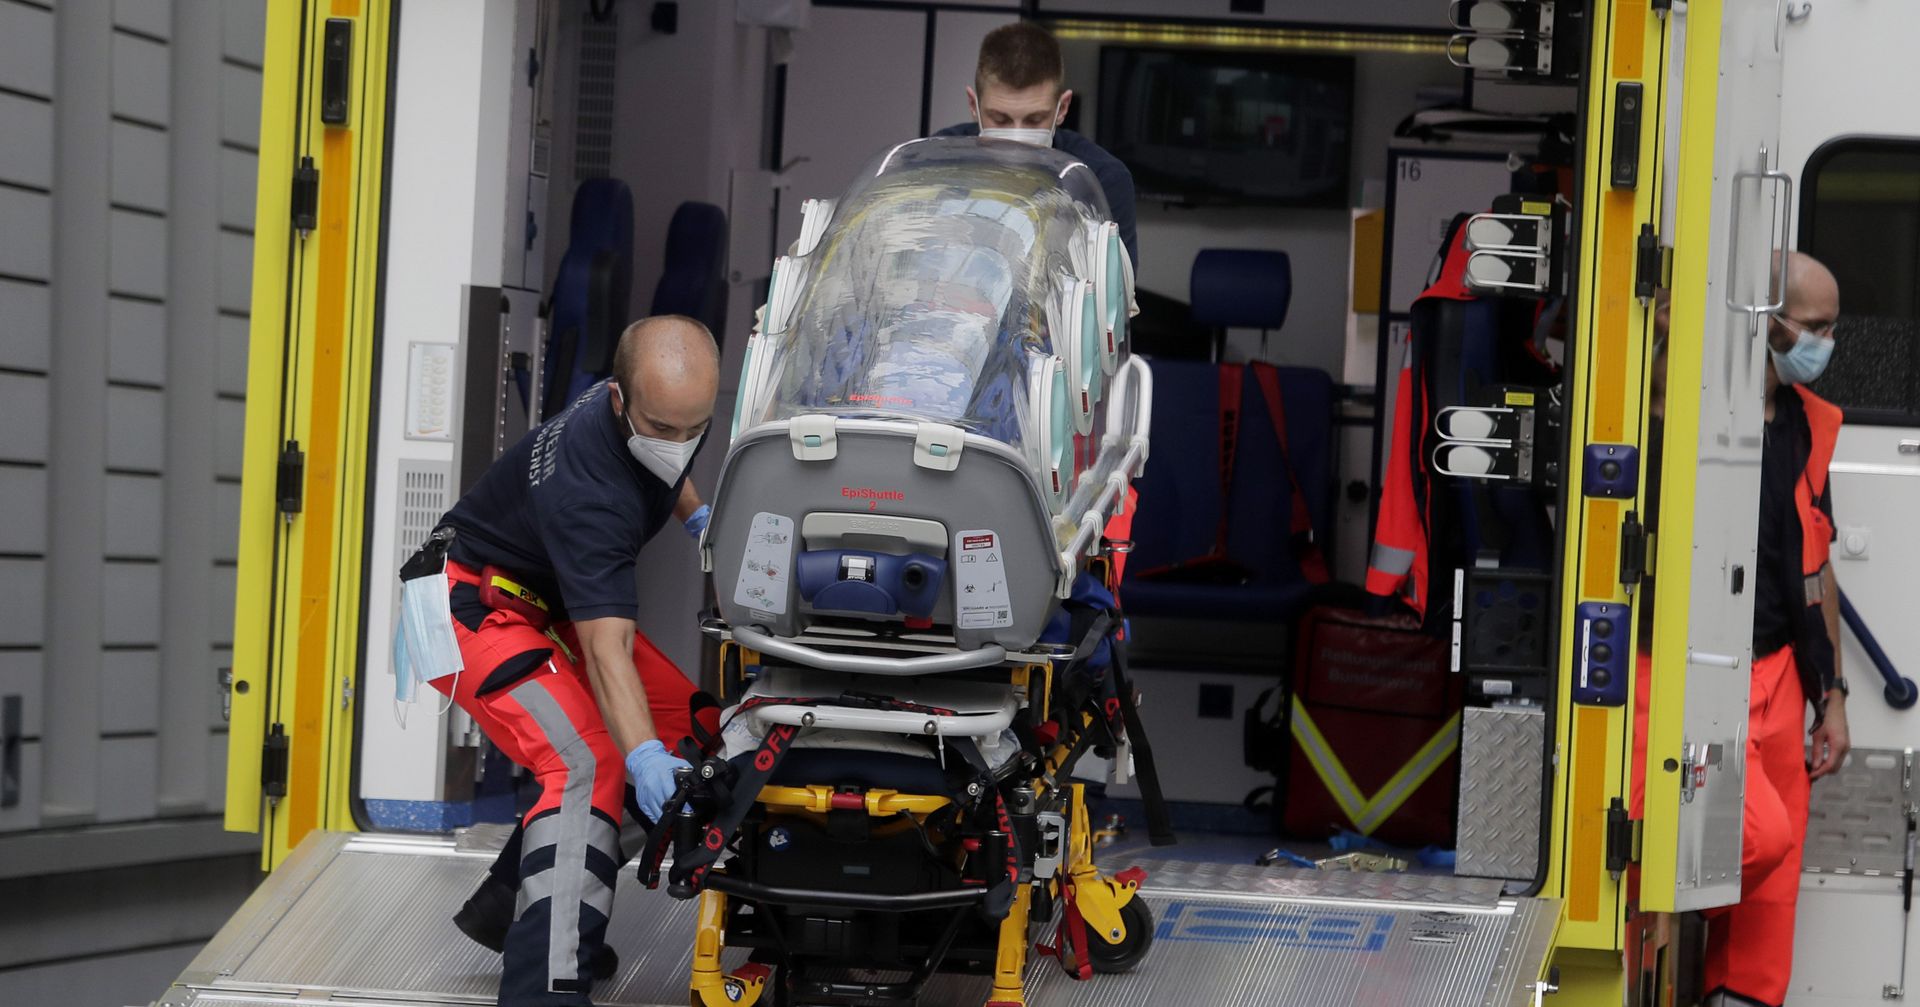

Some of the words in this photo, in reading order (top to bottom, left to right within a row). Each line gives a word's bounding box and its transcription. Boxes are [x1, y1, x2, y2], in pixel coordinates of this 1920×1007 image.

[1400, 160, 1422, 183] 16
[841, 487, 904, 501] EpiShuttle
[868, 501, 877, 511] 2
